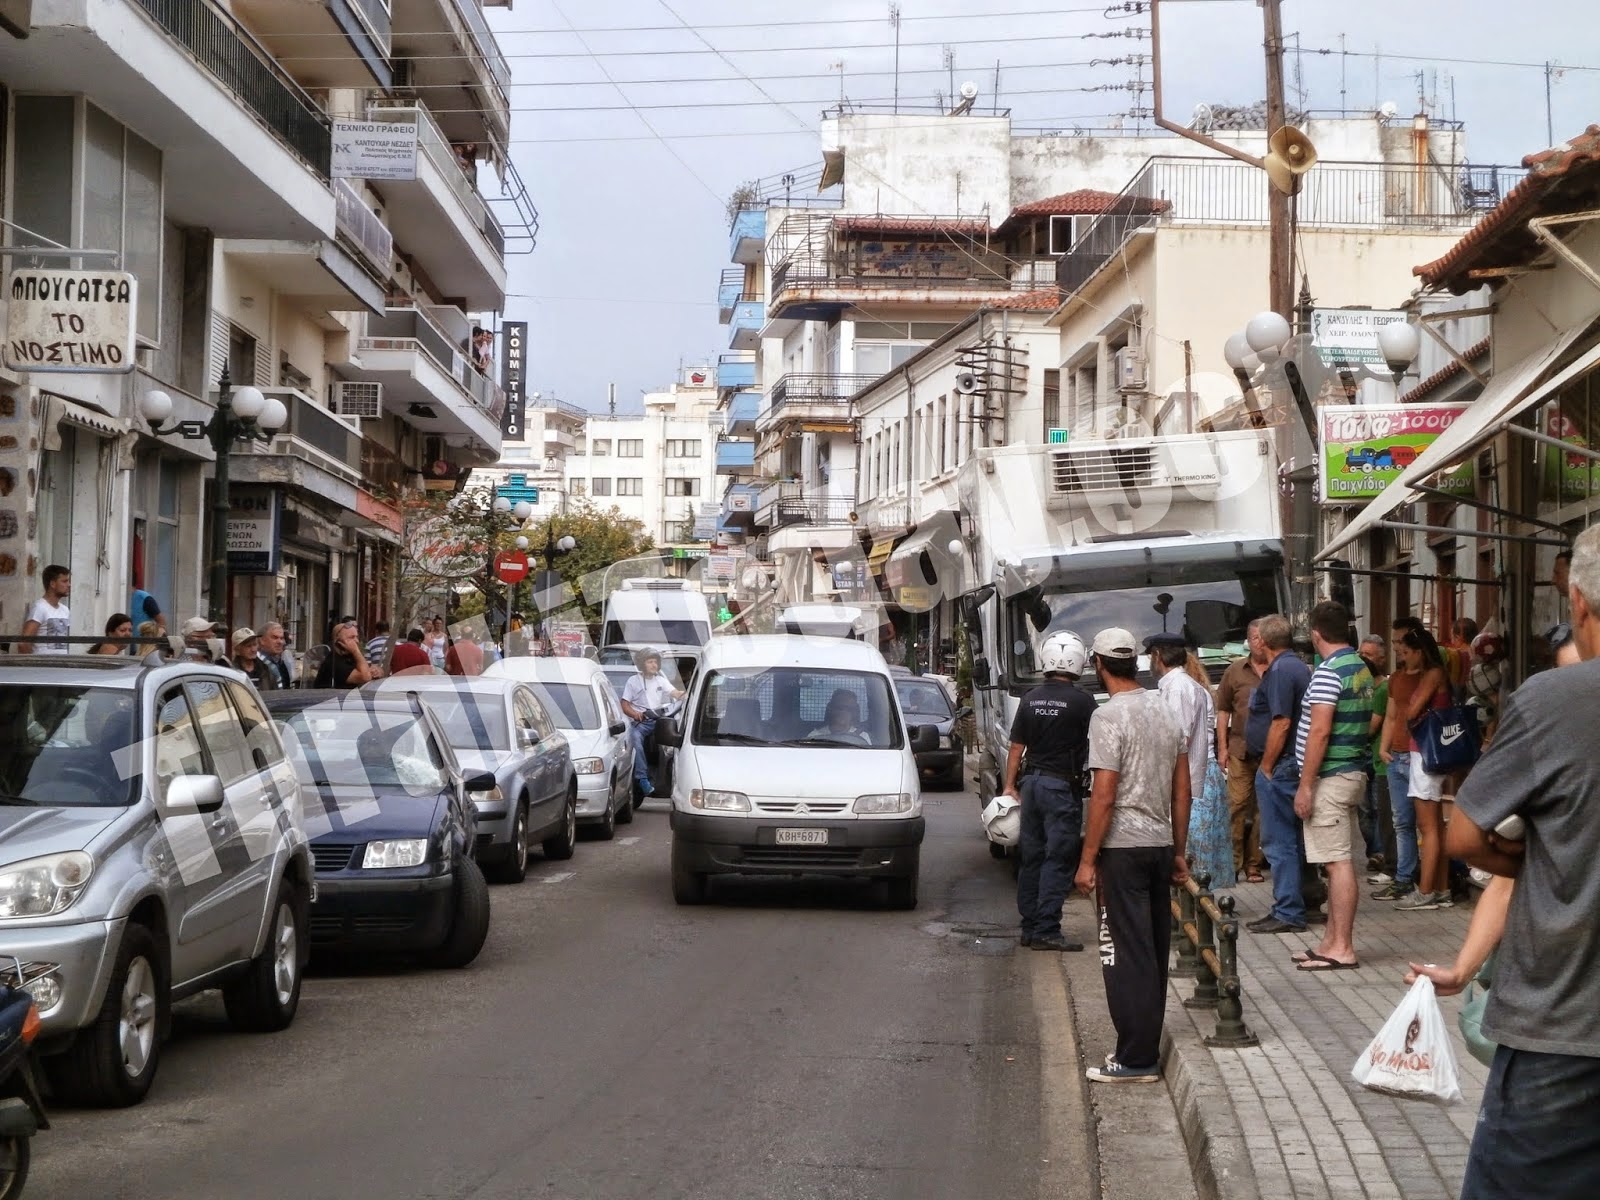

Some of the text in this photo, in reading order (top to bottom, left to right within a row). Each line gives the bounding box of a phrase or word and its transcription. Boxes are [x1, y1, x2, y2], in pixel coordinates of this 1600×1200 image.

[336, 124, 415, 134] ΤΕΧΝΙΚΟ ΓΡΑΦΕΙΟ
[51, 312, 85, 334] ΤΟ
[11, 340, 122, 365] ΝΟΣΤΙΜΟ
[507, 326, 520, 435] ΚΟΜΜΩΤΗΡΙΟ
[1331, 475, 1387, 494] Παιχνίδια
[226, 522, 258, 530] ΕΝΤΡΑ
[226, 531, 253, 539] ΕΝΩΝ
[226, 541, 263, 549] ΛΩΣΣΩΝ
[1034, 708, 1060, 716] POLICE
[1442, 723, 1462, 737] NIKE
